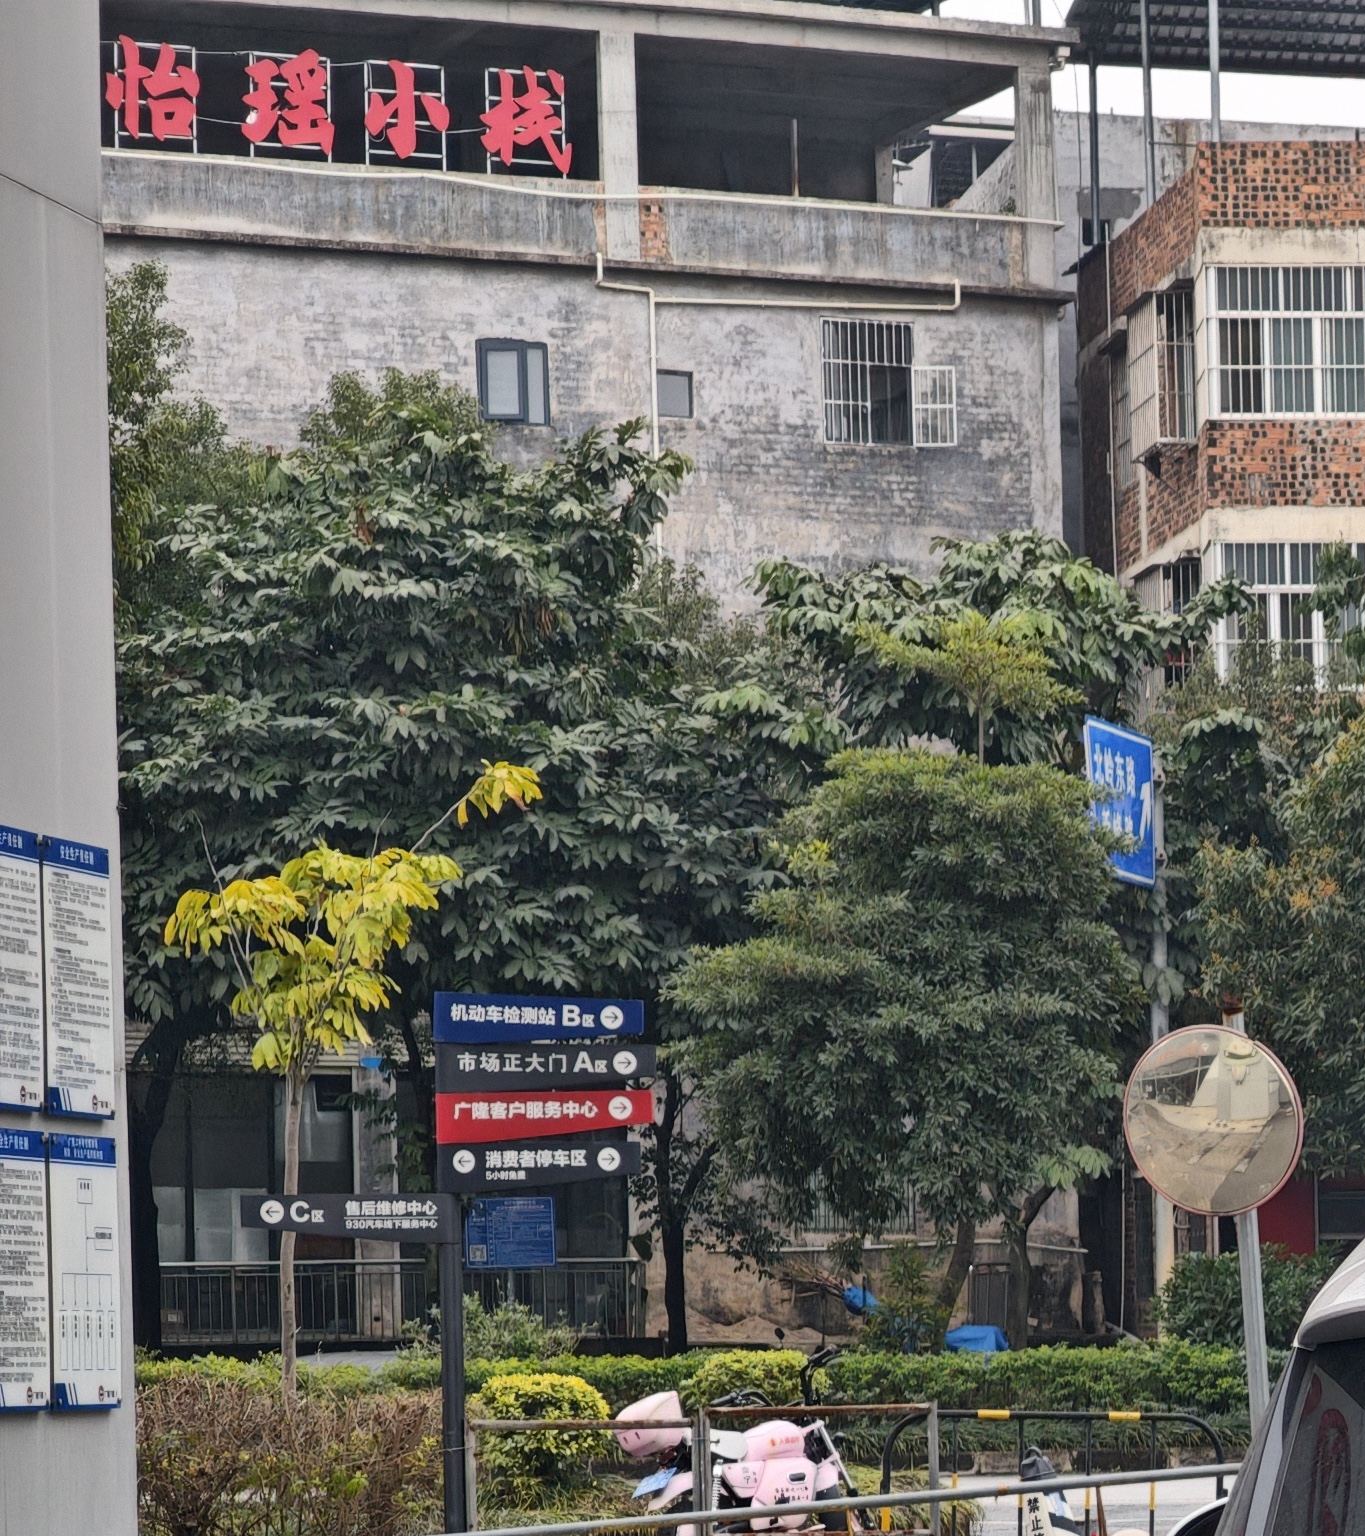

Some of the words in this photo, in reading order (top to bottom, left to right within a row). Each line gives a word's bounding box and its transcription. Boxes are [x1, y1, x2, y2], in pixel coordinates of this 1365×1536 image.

[105, 34, 573, 175] 怡瑶小栈
[451, 1003, 556, 1025] 机动车检测站
[562, 1004, 595, 1028] B区
[457, 1051, 567, 1073] 市场正大门
[572, 1050, 608, 1074] A区
[454, 1100, 598, 1120] 广隆客户服务中心
[485, 1149, 588, 1168] 消费者停车区
[345, 1200, 438, 1217] 售后维修中心
